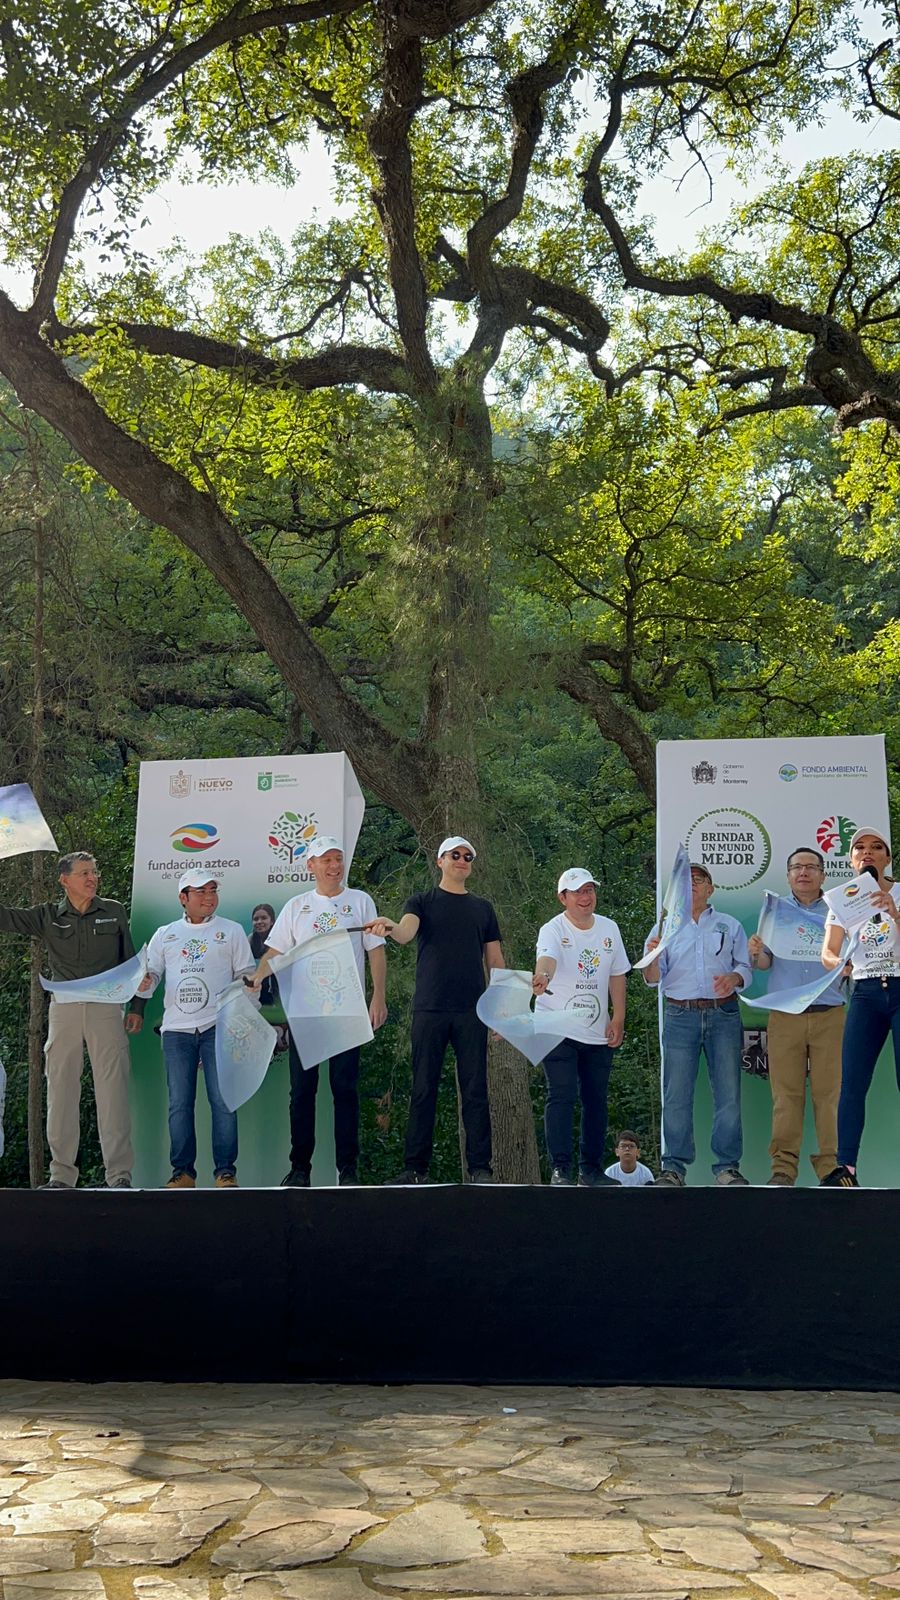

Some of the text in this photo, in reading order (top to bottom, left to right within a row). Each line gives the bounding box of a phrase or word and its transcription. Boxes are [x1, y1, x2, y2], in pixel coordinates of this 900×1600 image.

[801, 765, 868, 773] FONDO AMBIENTAL
[199, 780, 233, 788] NUEVO
[701, 832, 755, 842] BRINDAR
[701, 843, 755, 852] UN MUNDO
[701, 853, 755, 865] MEJOR
[148, 859, 240, 870] fundación azteca
[269, 864, 308, 873] UN NUEV
[161, 871, 173, 880] de
[267, 872, 316, 883] BOSQUE
[826, 870, 854, 878] MÉXICO
[791, 949, 822, 957] BOSQU
[864, 951, 895, 959] BOSQUE
